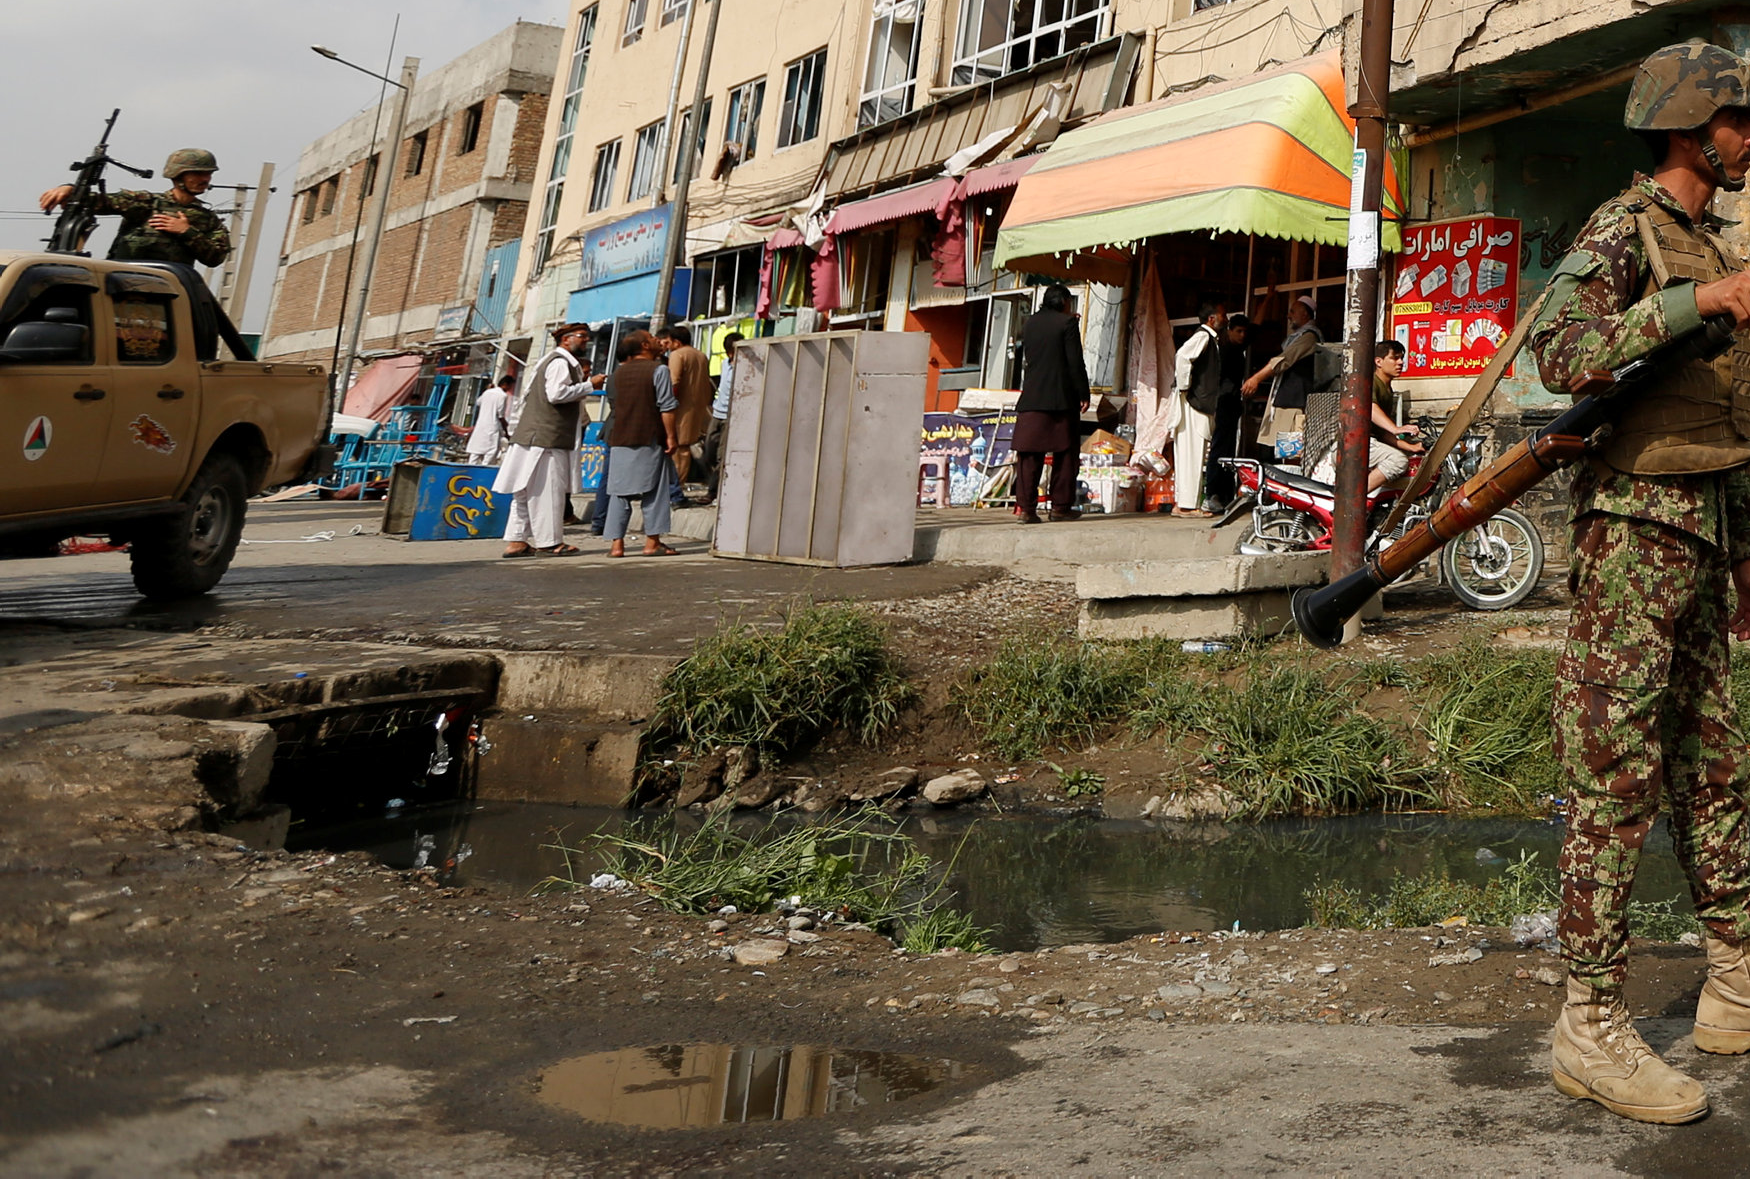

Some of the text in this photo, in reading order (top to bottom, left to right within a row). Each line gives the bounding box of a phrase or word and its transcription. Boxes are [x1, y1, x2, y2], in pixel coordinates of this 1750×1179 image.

[1402, 221, 1514, 262] صرافی امارات
[1433, 299, 1450, 316] کارت
[1485, 297, 1510, 313] کارت
[1415, 353, 1427, 368] 3G
